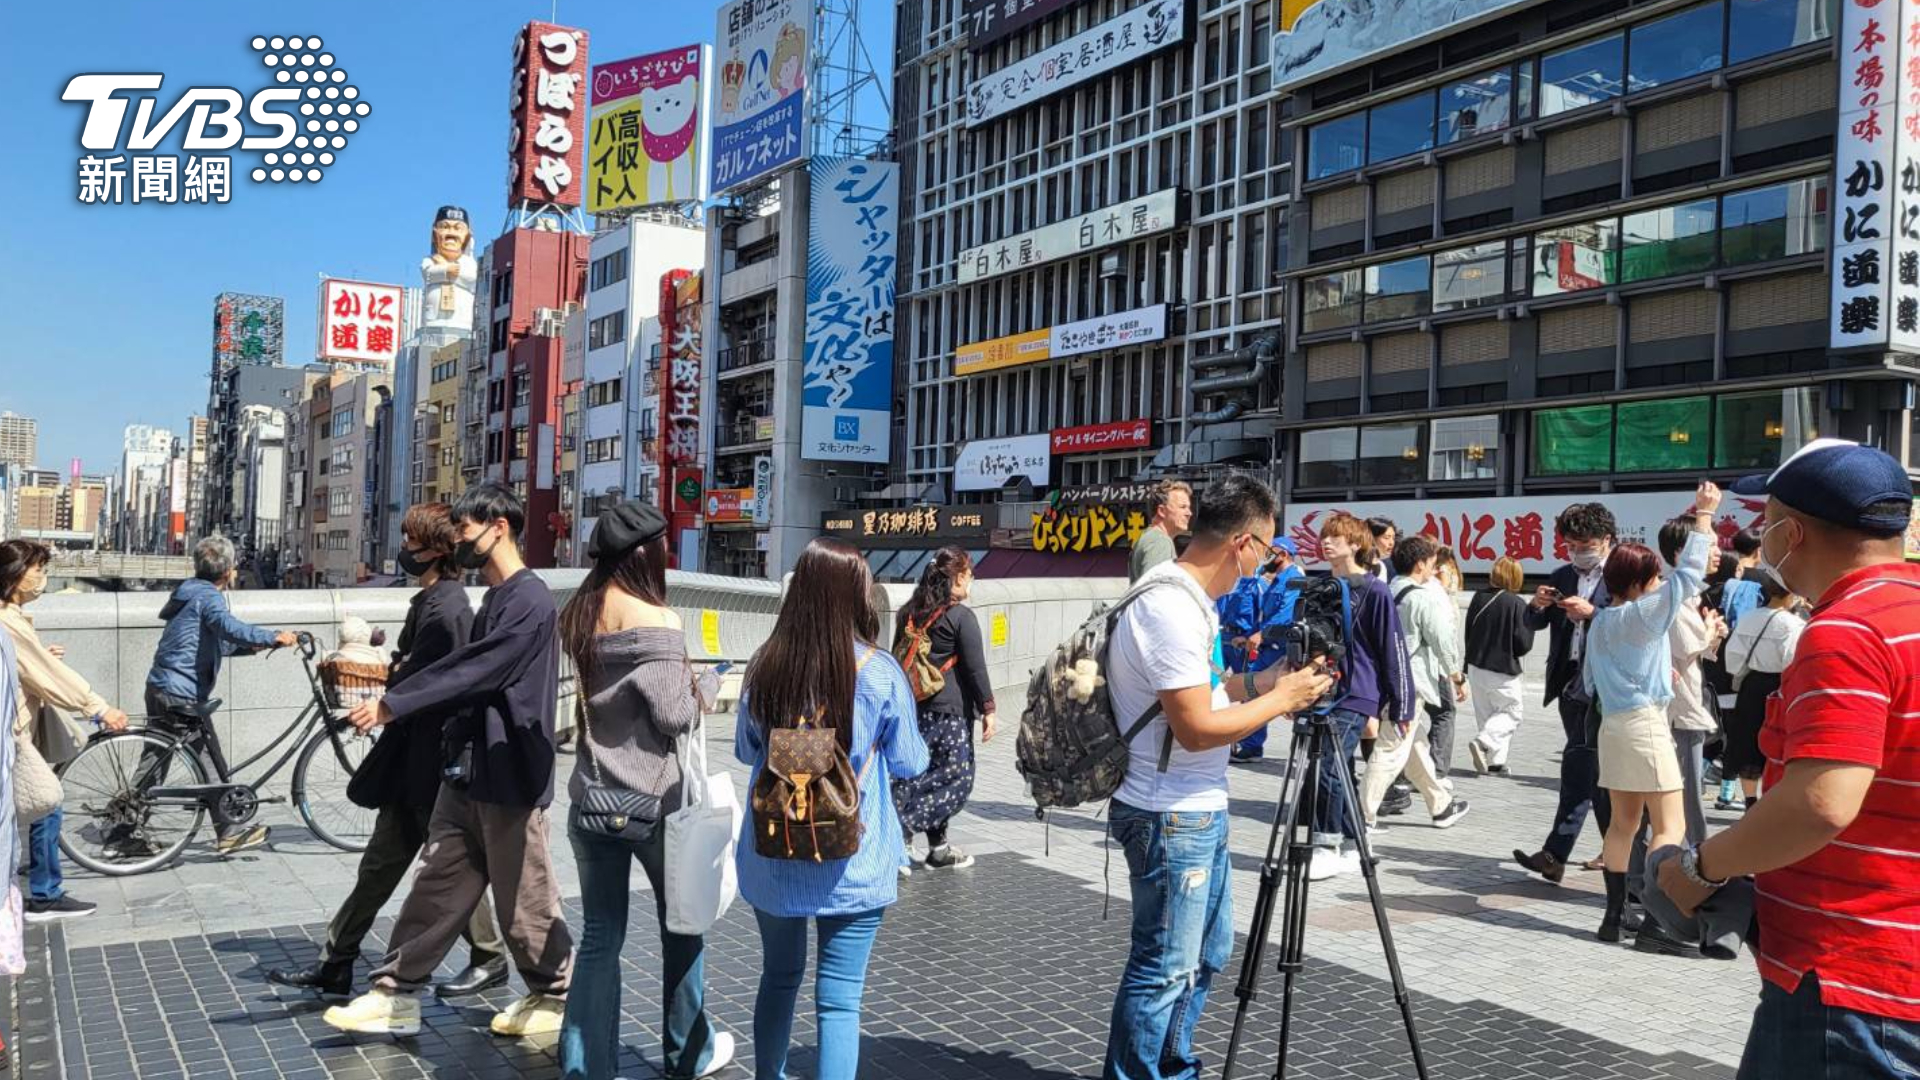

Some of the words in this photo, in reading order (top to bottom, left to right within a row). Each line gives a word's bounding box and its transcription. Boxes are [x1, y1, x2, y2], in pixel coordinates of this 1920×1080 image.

[728, 0, 803, 35] 店舗の
[973, 3, 996, 37] 7F
[614, 56, 686, 85] いちごなび
[1001, 22, 1137, 103] 完全個室居酒屋
[1852, 18, 1886, 143] 本場の味
[535, 31, 583, 196] づぼらや
[593, 113, 619, 207] バイト
[615, 109, 641, 203] 高収入
[716, 124, 797, 184] ガルフネット
[1079, 203, 1149, 249] 白木屋
[1841, 159, 1884, 334] かに道楽
[976, 238, 1033, 278] 白木屋
[333, 289, 393, 322] かに
[838, 421, 856, 435] BX
[863, 507, 939, 536] 星乃珈琲店
[950, 514, 982, 527] COFFEE
